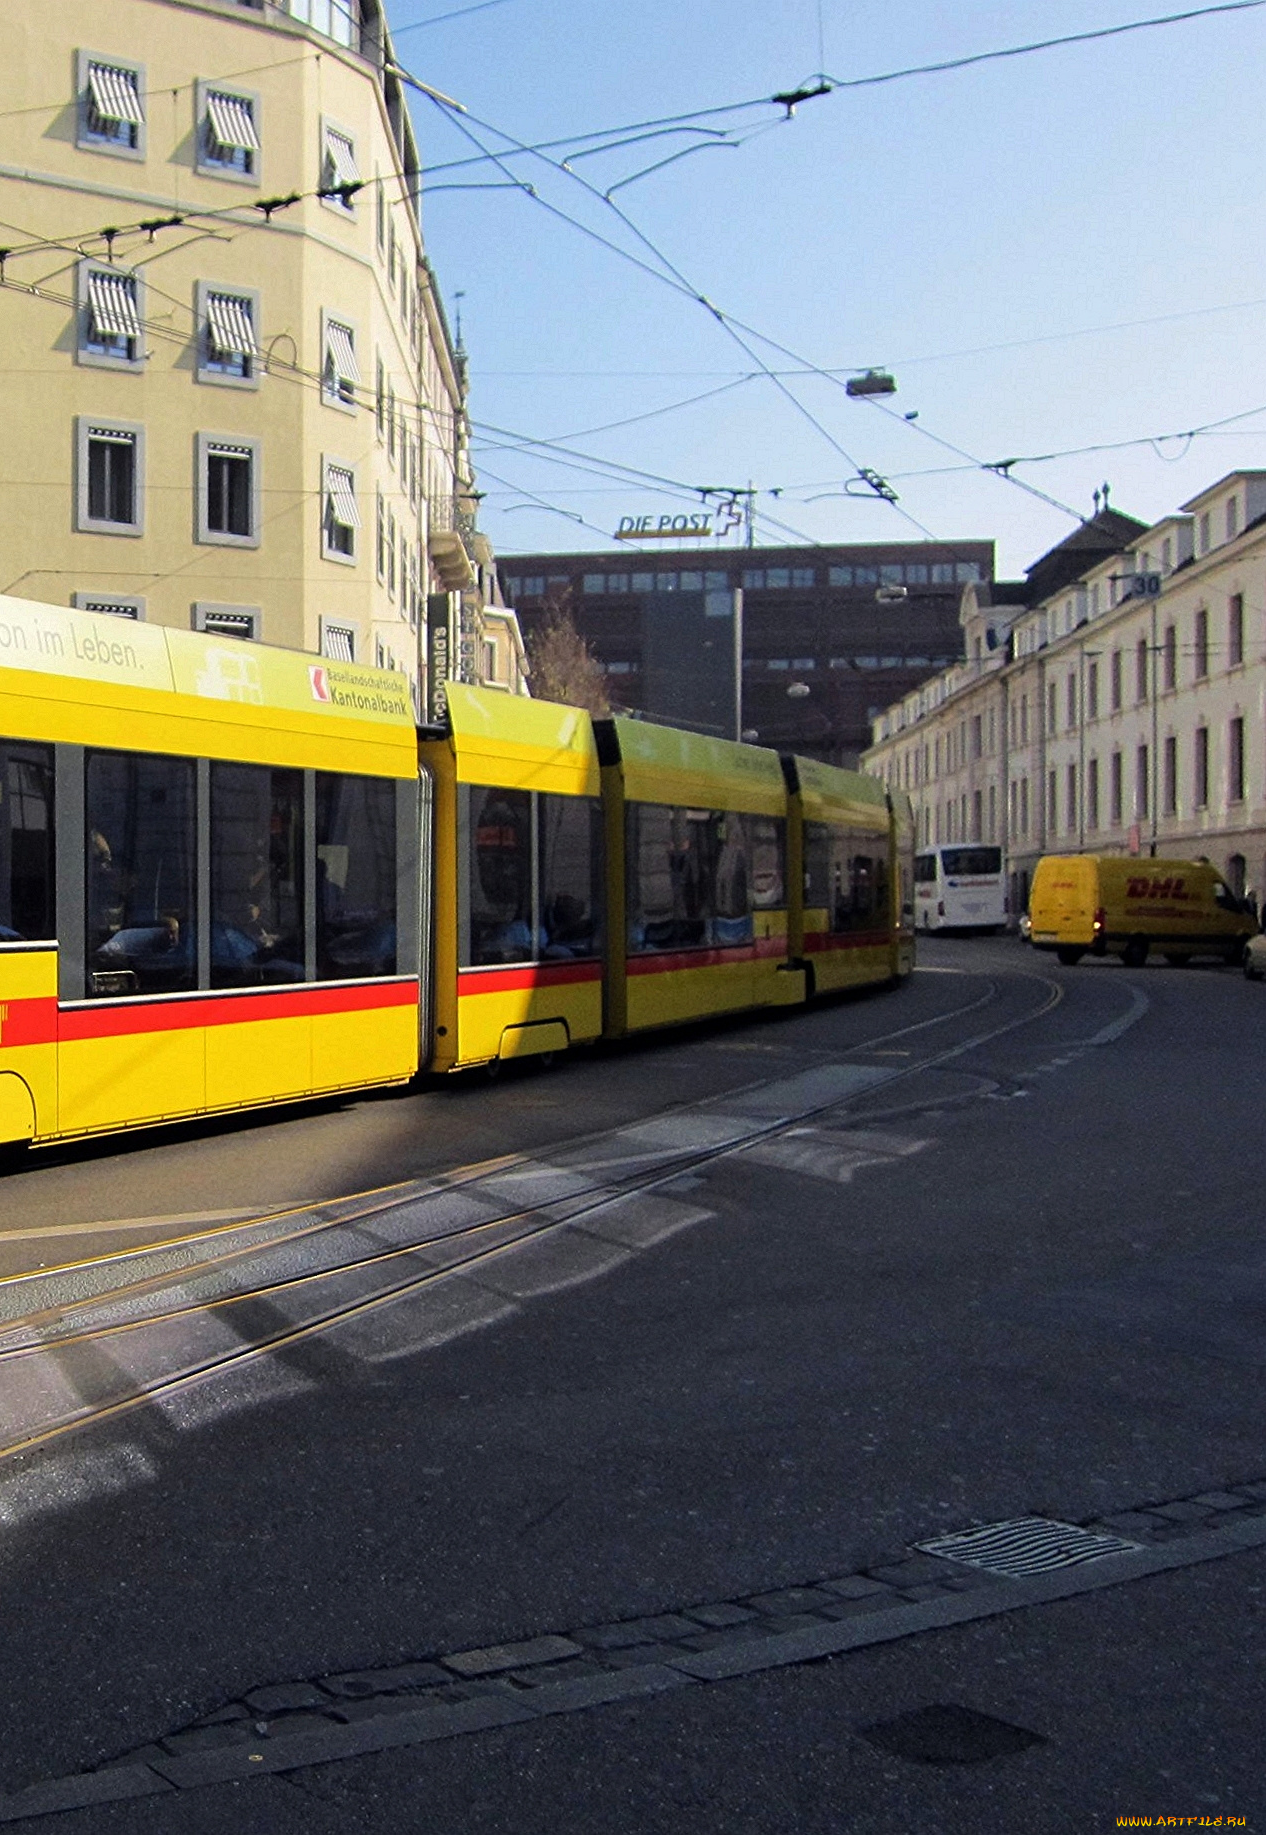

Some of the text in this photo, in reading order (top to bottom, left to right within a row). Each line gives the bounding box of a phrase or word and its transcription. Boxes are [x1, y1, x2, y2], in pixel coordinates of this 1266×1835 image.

[619, 514, 713, 532] DIE POST
[1134, 575, 1160, 595] 30
[34, 617, 65, 657] im
[70, 622, 145, 670] Leben.
[433, 626, 447, 721] cDonald's
[330, 686, 408, 716] Kantonalbank
[1127, 876, 1189, 900] DHL
